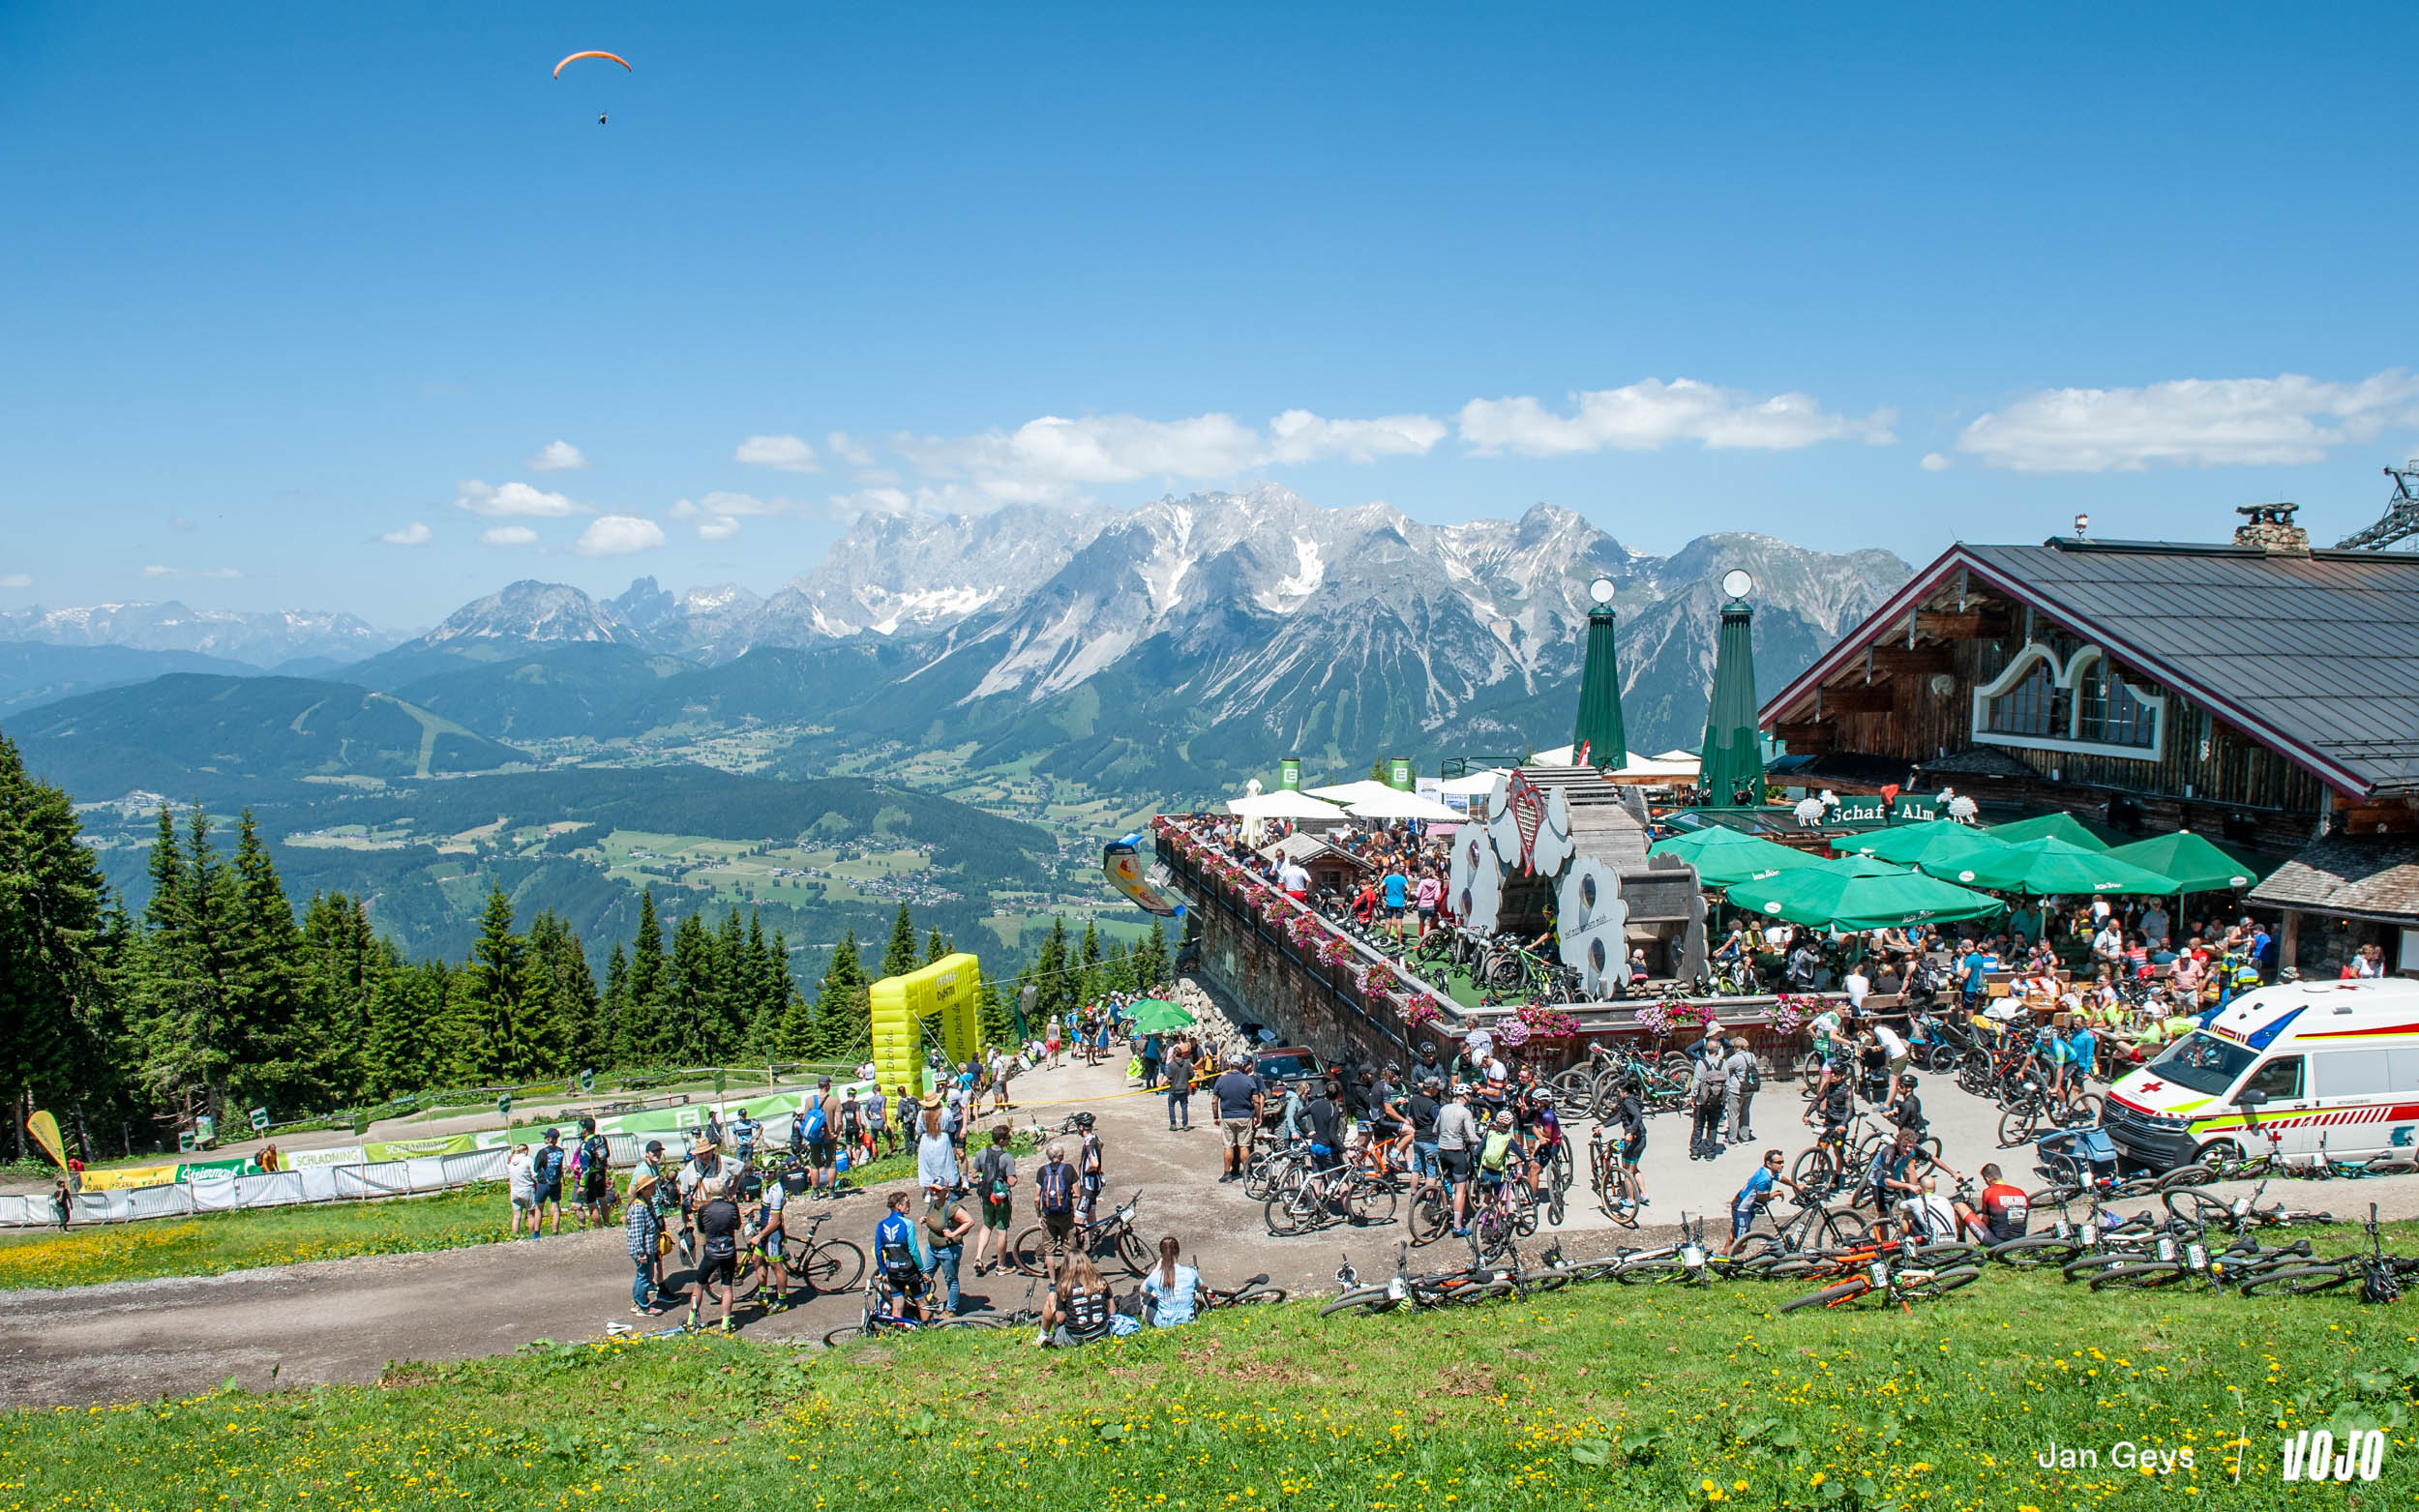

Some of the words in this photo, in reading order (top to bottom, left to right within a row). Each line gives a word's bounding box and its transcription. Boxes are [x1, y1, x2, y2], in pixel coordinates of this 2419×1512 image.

[1832, 804, 1886, 823] Schaf
[1901, 804, 1935, 821] Alm
[953, 1015, 963, 1036] Dich
[885, 1047, 895, 1069] Dich
[886, 1072, 896, 1086] für
[385, 1140, 448, 1155] SCHLADMING
[296, 1147, 359, 1167] SCHLADMING
[2193, 1248, 2201, 1263] 302
[1874, 1267, 1884, 1283] 243
